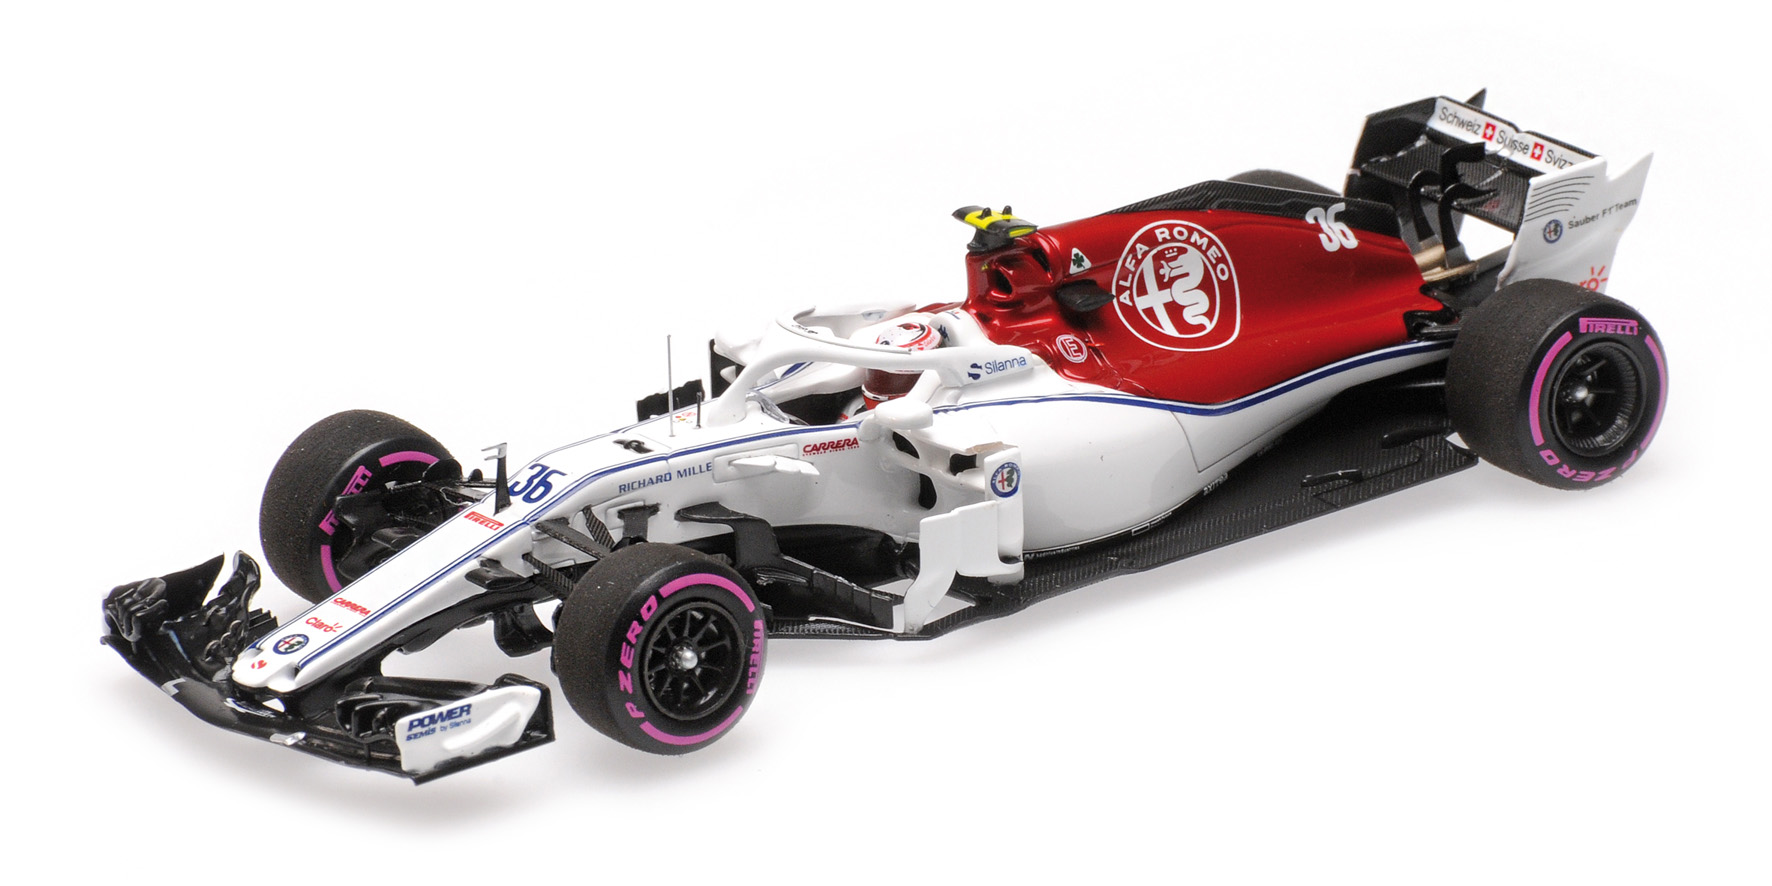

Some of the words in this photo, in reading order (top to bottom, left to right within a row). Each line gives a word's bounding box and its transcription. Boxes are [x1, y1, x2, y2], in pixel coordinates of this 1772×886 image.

[1438, 106, 1482, 136] Schweiz
[1496, 129, 1530, 155] Suisse
[1305, 203, 1358, 252] 36
[1567, 213, 1600, 230] Sauber
[1613, 198, 1638, 212] Team
[1119, 242, 1150, 306] ALFA
[1155, 226, 1229, 282] ROMEO
[1579, 317, 1640, 336] PIRELLI
[984, 356, 1027, 375] Silanna
[802, 437, 859, 453] CARRERA
[618, 472, 673, 494] RICHARD
[676, 461, 713, 480] MILLE
[1539, 449, 1617, 482] ZERO
[508, 463, 568, 504] 36
[463, 511, 505, 531] PIRELLI
[333, 597, 371, 616] CARRERA
[305, 616, 334, 633] Claro
[618, 594, 658, 694] ZERO
[407, 703, 472, 732] POWER
[625, 702, 645, 719] P
